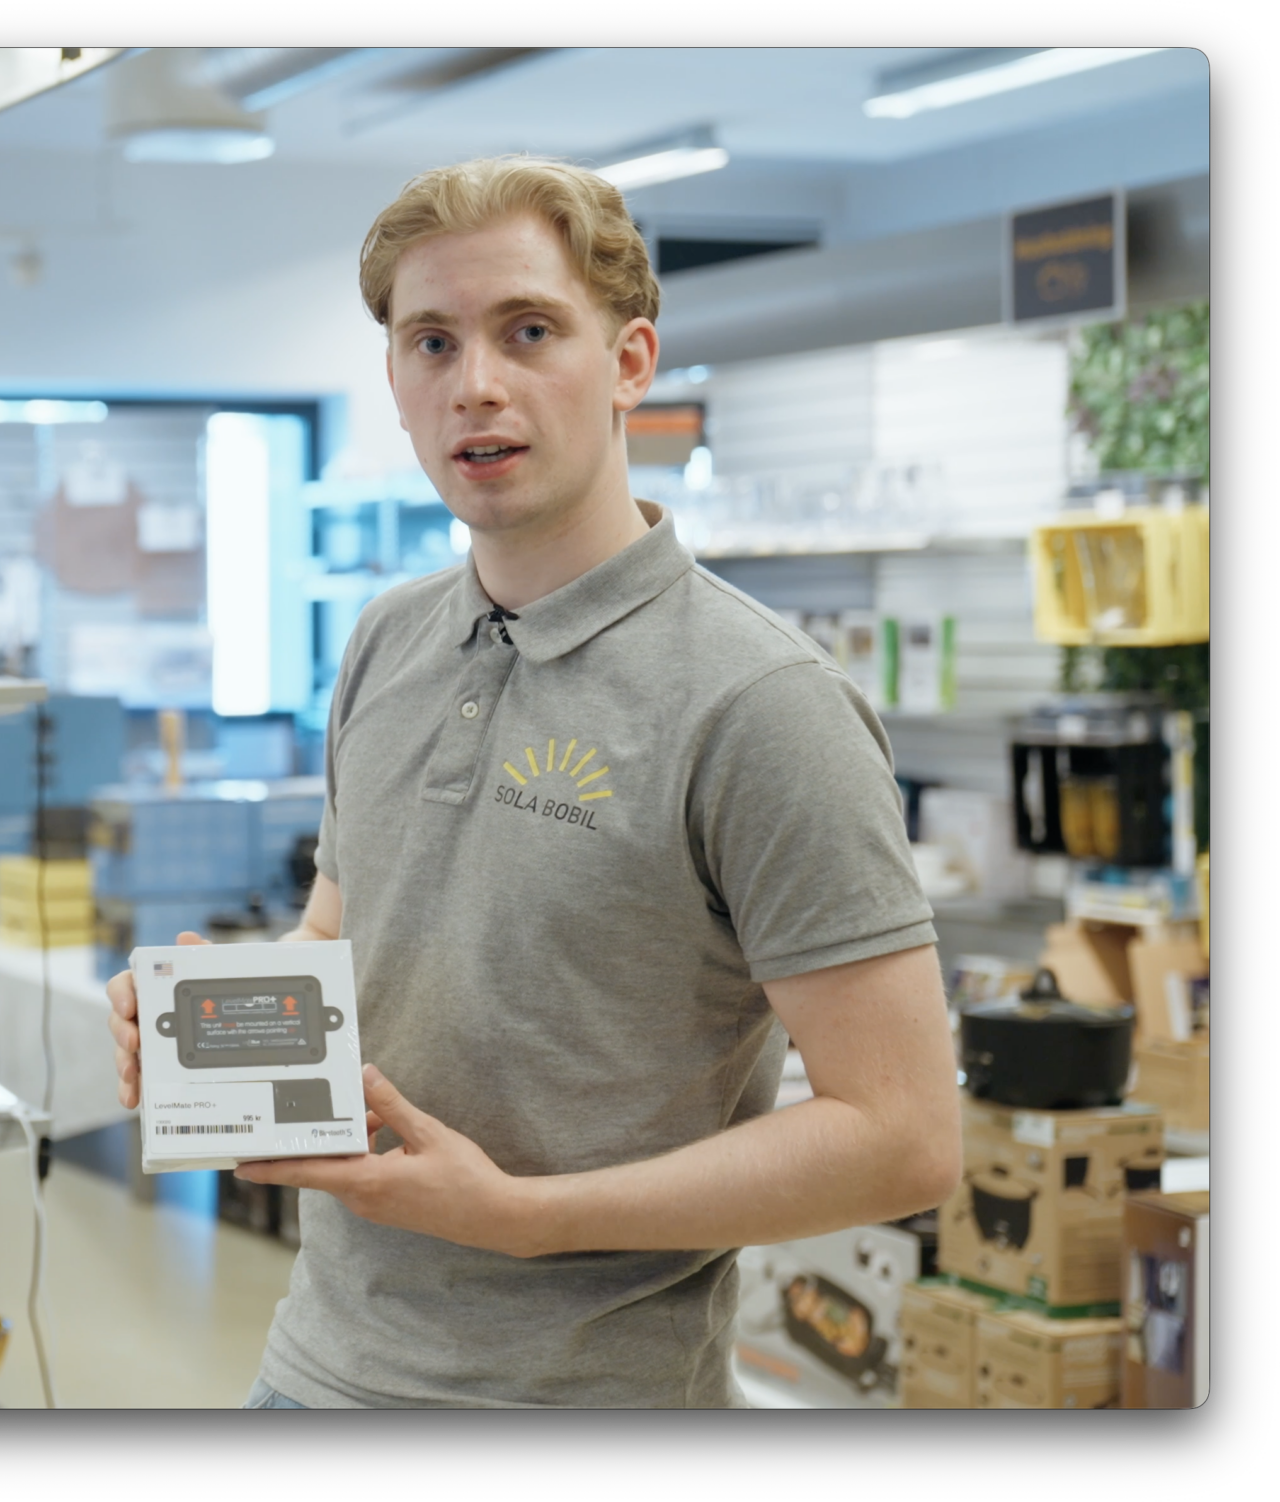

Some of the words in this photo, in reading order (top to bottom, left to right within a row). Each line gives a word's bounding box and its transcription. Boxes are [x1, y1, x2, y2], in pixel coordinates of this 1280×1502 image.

[494, 784, 538, 813] SOLA
[542, 799, 597, 831] BOBIL
[266, 1027, 287, 1035] pointing
[154, 1102, 192, 1110] LevelMate
[346, 1128, 353, 1138] 5
